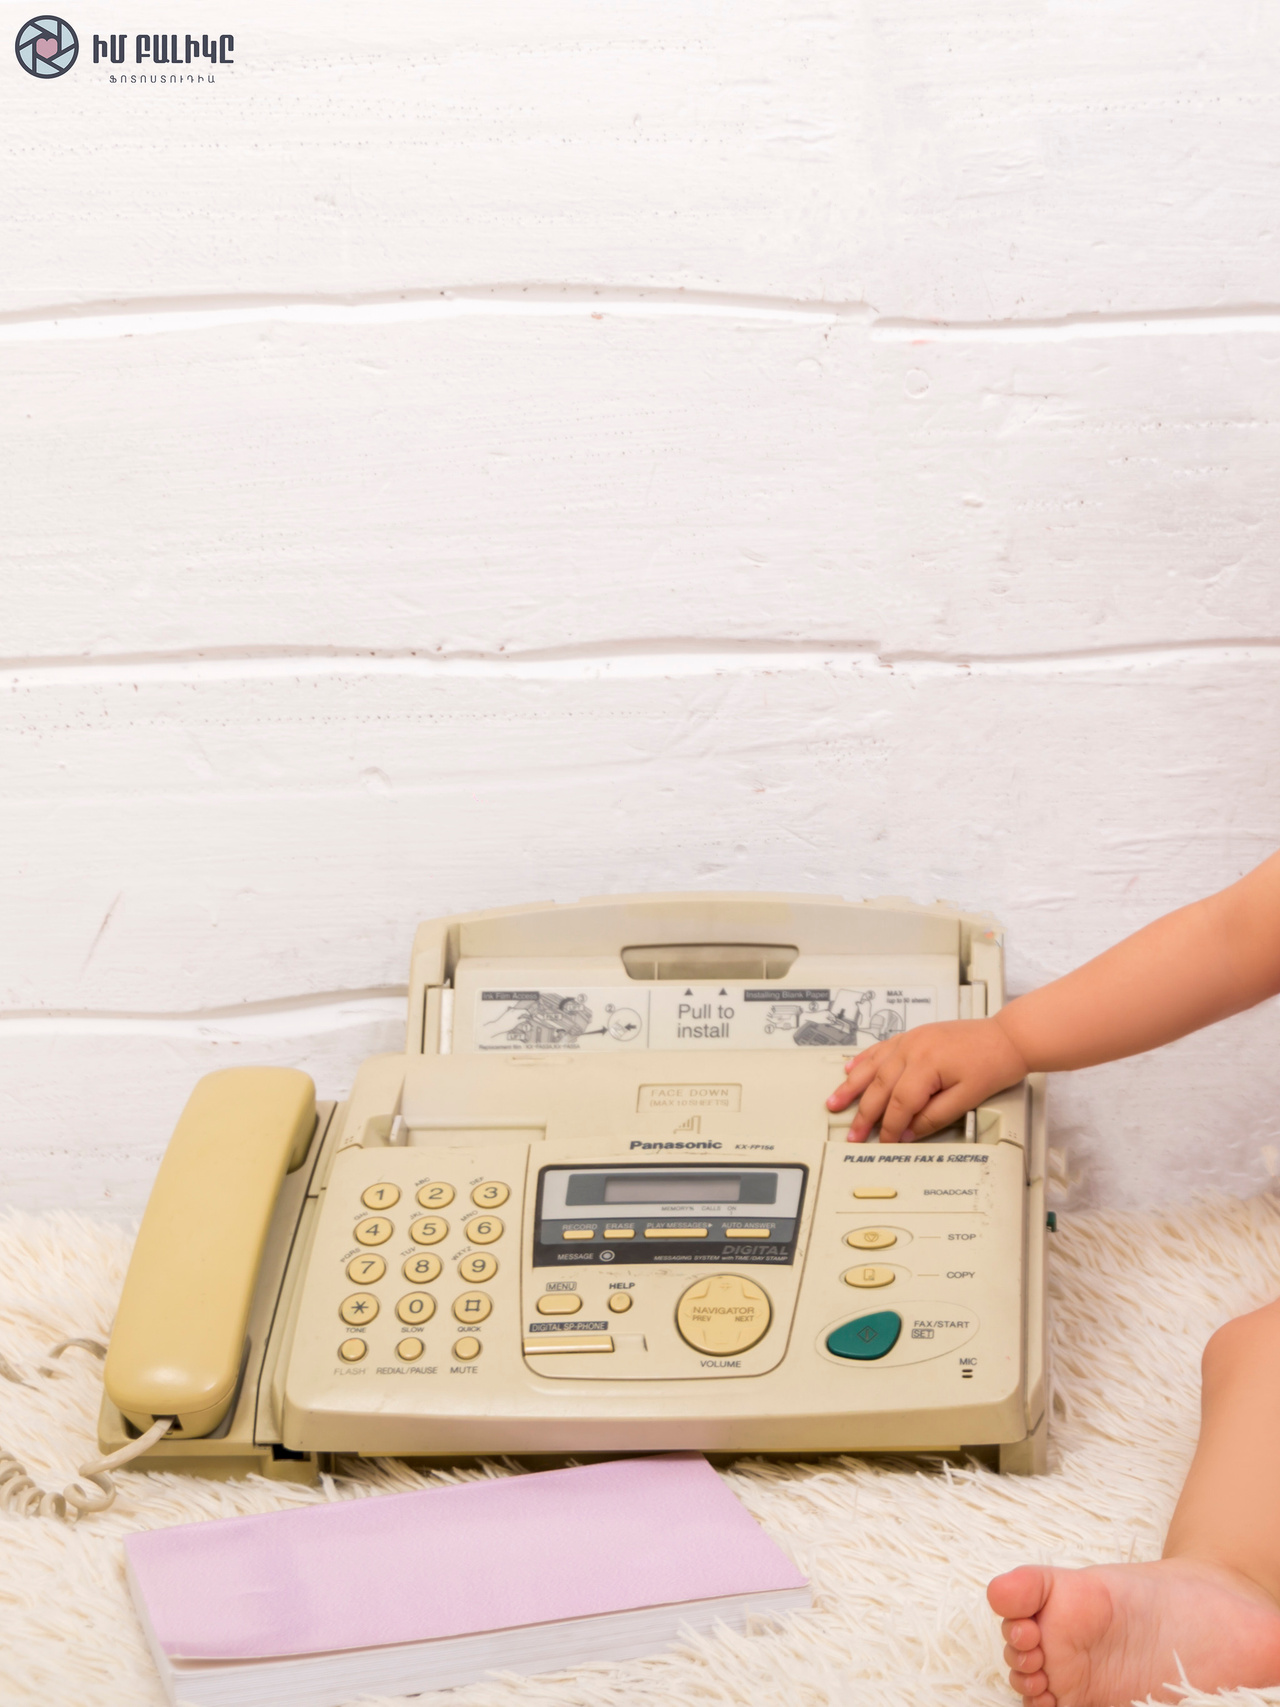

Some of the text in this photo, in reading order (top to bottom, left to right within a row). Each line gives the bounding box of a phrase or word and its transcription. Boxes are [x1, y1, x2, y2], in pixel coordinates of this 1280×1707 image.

[483, 992, 538, 1000] Ink Film Access
[746, 991, 829, 1000] Installing Blank Paper
[678, 1004, 735, 1019] Pull to
[677, 1023, 730, 1038] install
[651, 1088, 729, 1097] FACE DOWN
[629, 1139, 723, 1150] Panasonic
[843, 1155, 875, 1163] PLAIN
[877, 1155, 911, 1163] PAPER
[913, 1155, 934, 1163] FAX
[936, 1155, 944, 1163] &
[376, 1189, 385, 1200] 1
[428, 1188, 444, 1200] 2
[483, 1187, 498, 1199] 3
[460, 1210, 478, 1222] MNO
[365, 1223, 380, 1236] 4
[422, 1223, 437, 1236] 5
[477, 1222, 492, 1235] 6
[562, 1223, 598, 1231] RECORD
[947, 1233, 977, 1241] STOP
[722, 1245, 789, 1255] DIGITAL
[360, 1260, 376, 1274] 7
[415, 1259, 430, 1273] 8
[471, 1259, 486, 1273] 9
[946, 1271, 976, 1279] COPY
[547, 1283, 576, 1291] MENU
[609, 1282, 636, 1290] HELP
[692, 1306, 755, 1315] NAVIGATOR
[692, 1315, 712, 1323] PREV
[735, 1315, 755, 1323] NEXT
[530, 1322, 606, 1332] DIGITAL SP-PHONE
[913, 1320, 971, 1329] FAX/START
[912, 1330, 933, 1338] SET
[700, 1360, 742, 1368] VOLUME
[959, 1358, 978, 1366] MIC
[333, 1367, 366, 1376] FLASH
[376, 1366, 438, 1375] REDIAL/PAUSE
[450, 1366, 478, 1374] MUTE
